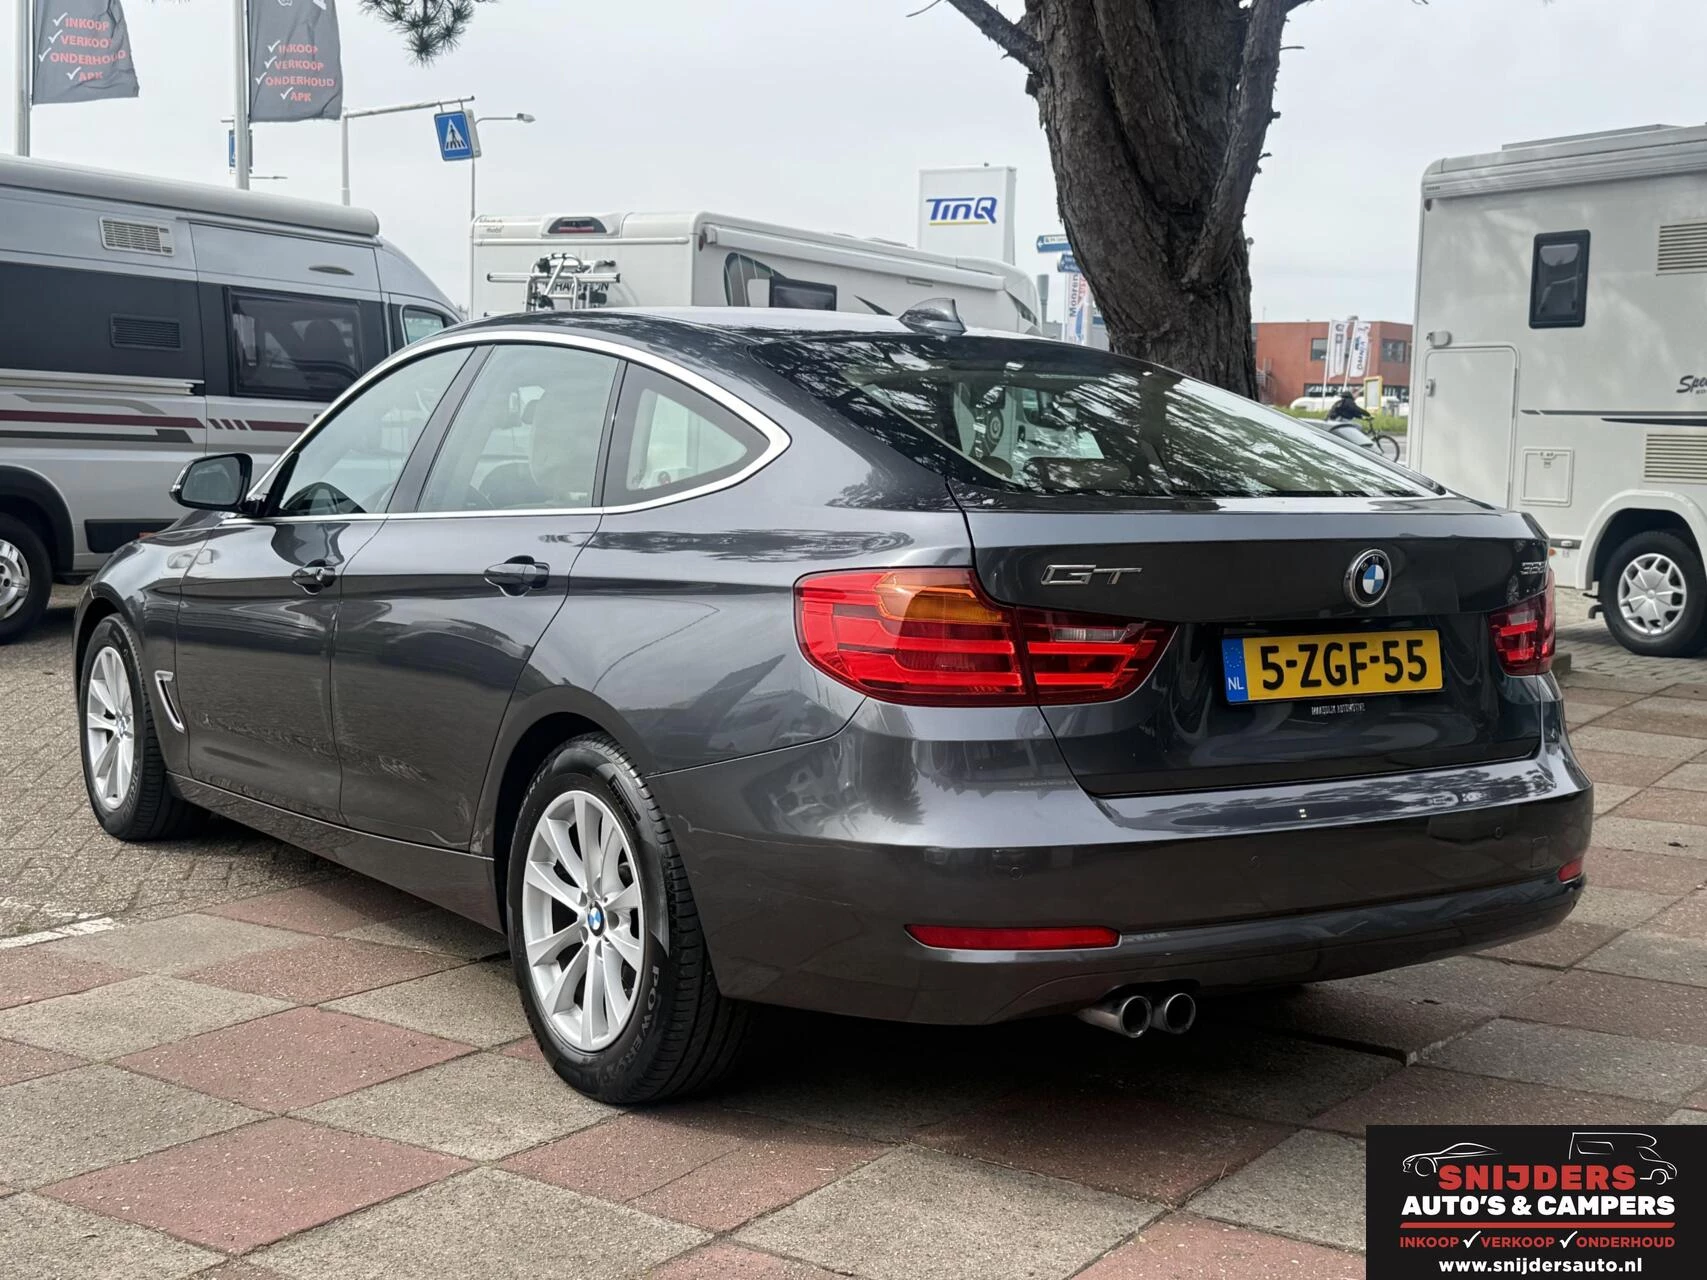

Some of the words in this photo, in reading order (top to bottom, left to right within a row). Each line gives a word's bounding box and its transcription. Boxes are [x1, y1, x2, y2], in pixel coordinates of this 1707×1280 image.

[64, 17, 110, 31] INKOOP
[274, 59, 324, 71] VERKOOP
[79, 71, 103, 82] APK
[265, 76, 335, 88] ONDERHOUD
[290, 91, 312, 102] APK
[1041, 564, 1143, 585] GT
[1228, 677, 1244, 690] NL
[1260, 639, 1427, 690] 5-ZGF-55
